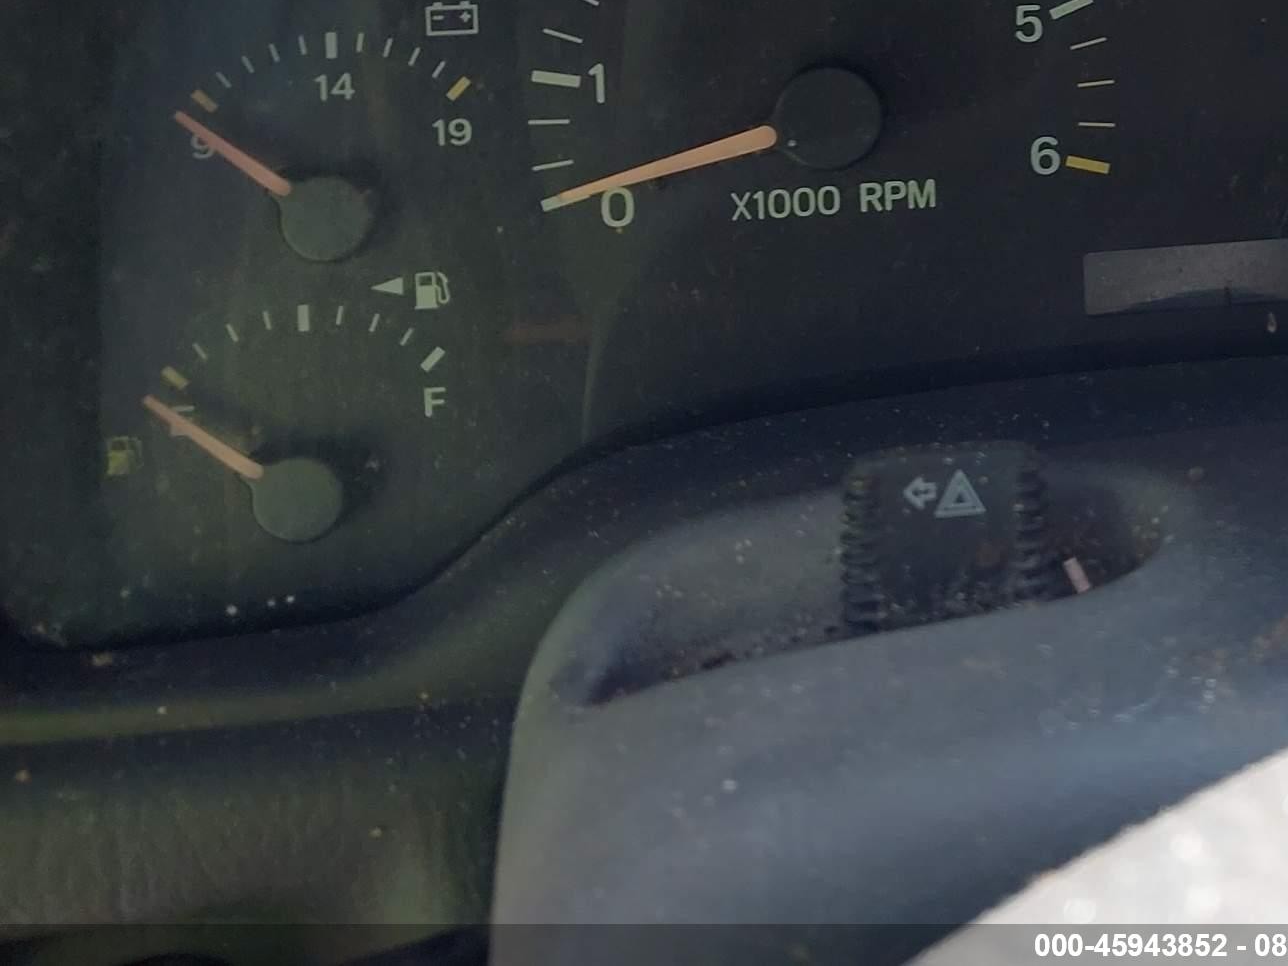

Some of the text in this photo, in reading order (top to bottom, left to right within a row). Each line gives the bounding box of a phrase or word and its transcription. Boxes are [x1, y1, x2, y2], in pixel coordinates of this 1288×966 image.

[1016, 4, 1043, 43] 5
[314, 73, 355, 101] 14
[588, 64, 605, 103] 1
[432, 119, 472, 146] 19
[1030, 136, 1061, 175] 6
[601, 188, 634, 227] 0
[731, 179, 936, 221] X1000 RPM
[424, 387, 446, 417] F
